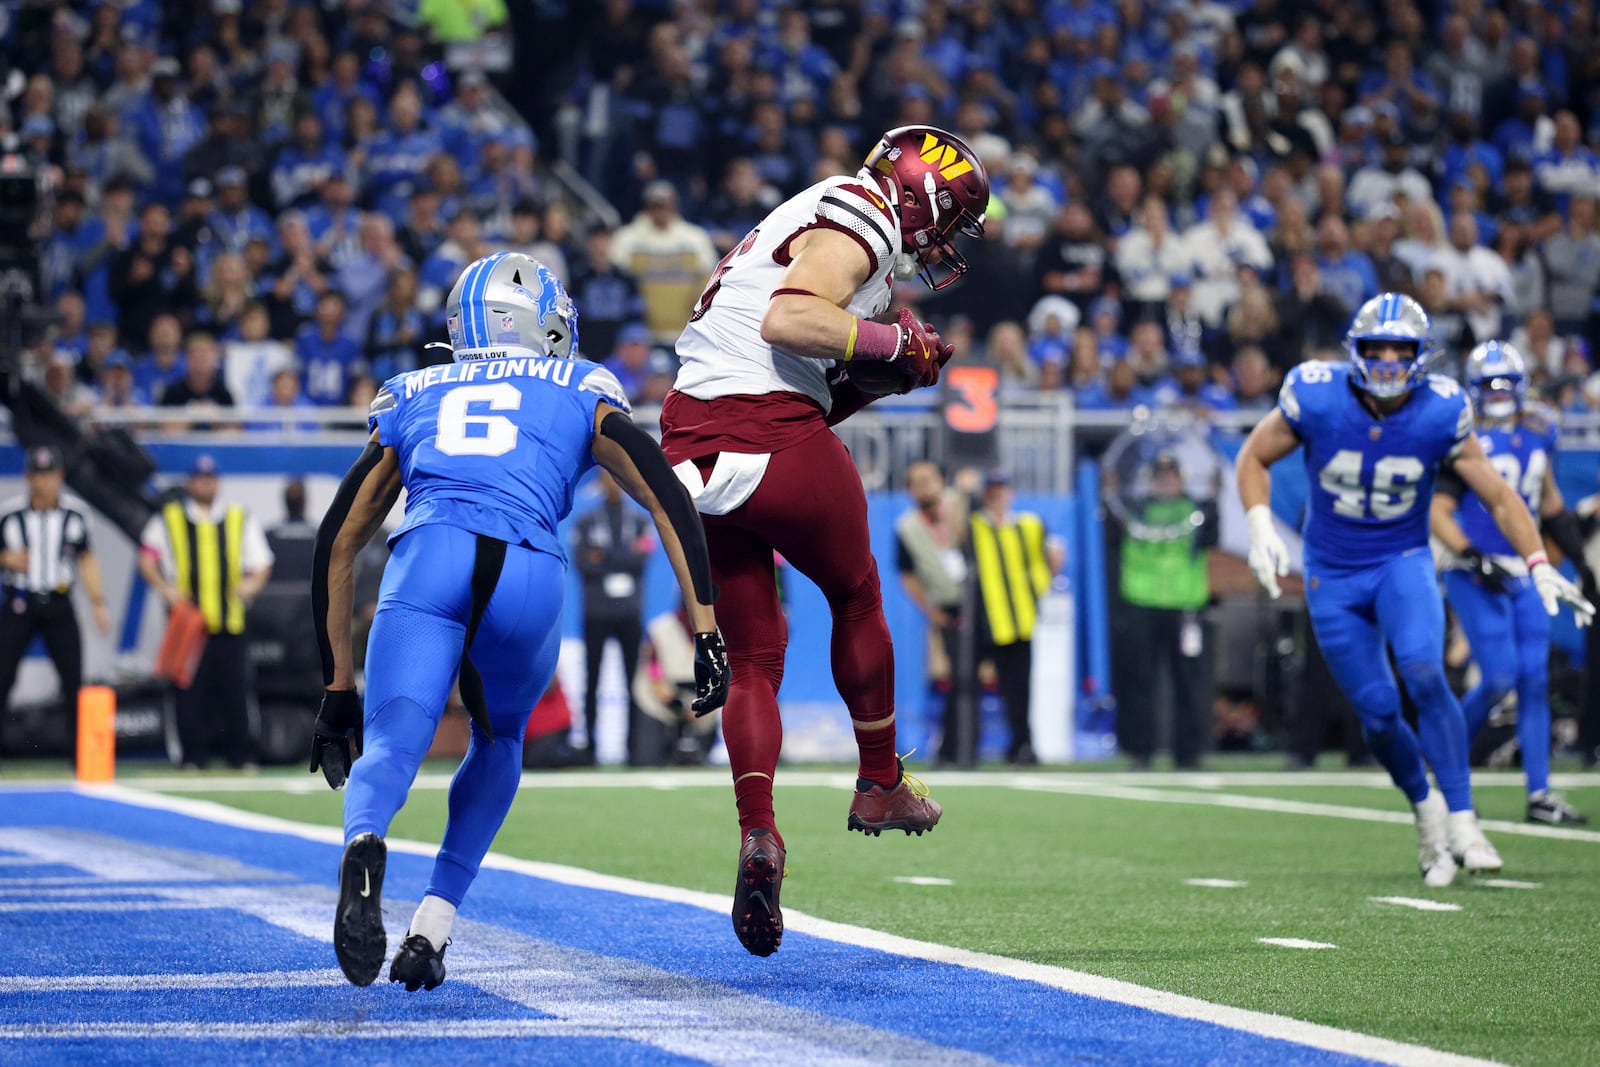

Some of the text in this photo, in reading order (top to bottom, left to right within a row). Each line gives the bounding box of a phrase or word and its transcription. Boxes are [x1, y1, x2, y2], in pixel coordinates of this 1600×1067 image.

[404, 358, 575, 399] MELIFONWU
[458, 351, 508, 361] CHOOSE LOVE
[434, 381, 522, 457] 6
[944, 366, 998, 433] 3
[1319, 449, 1425, 520] 46
